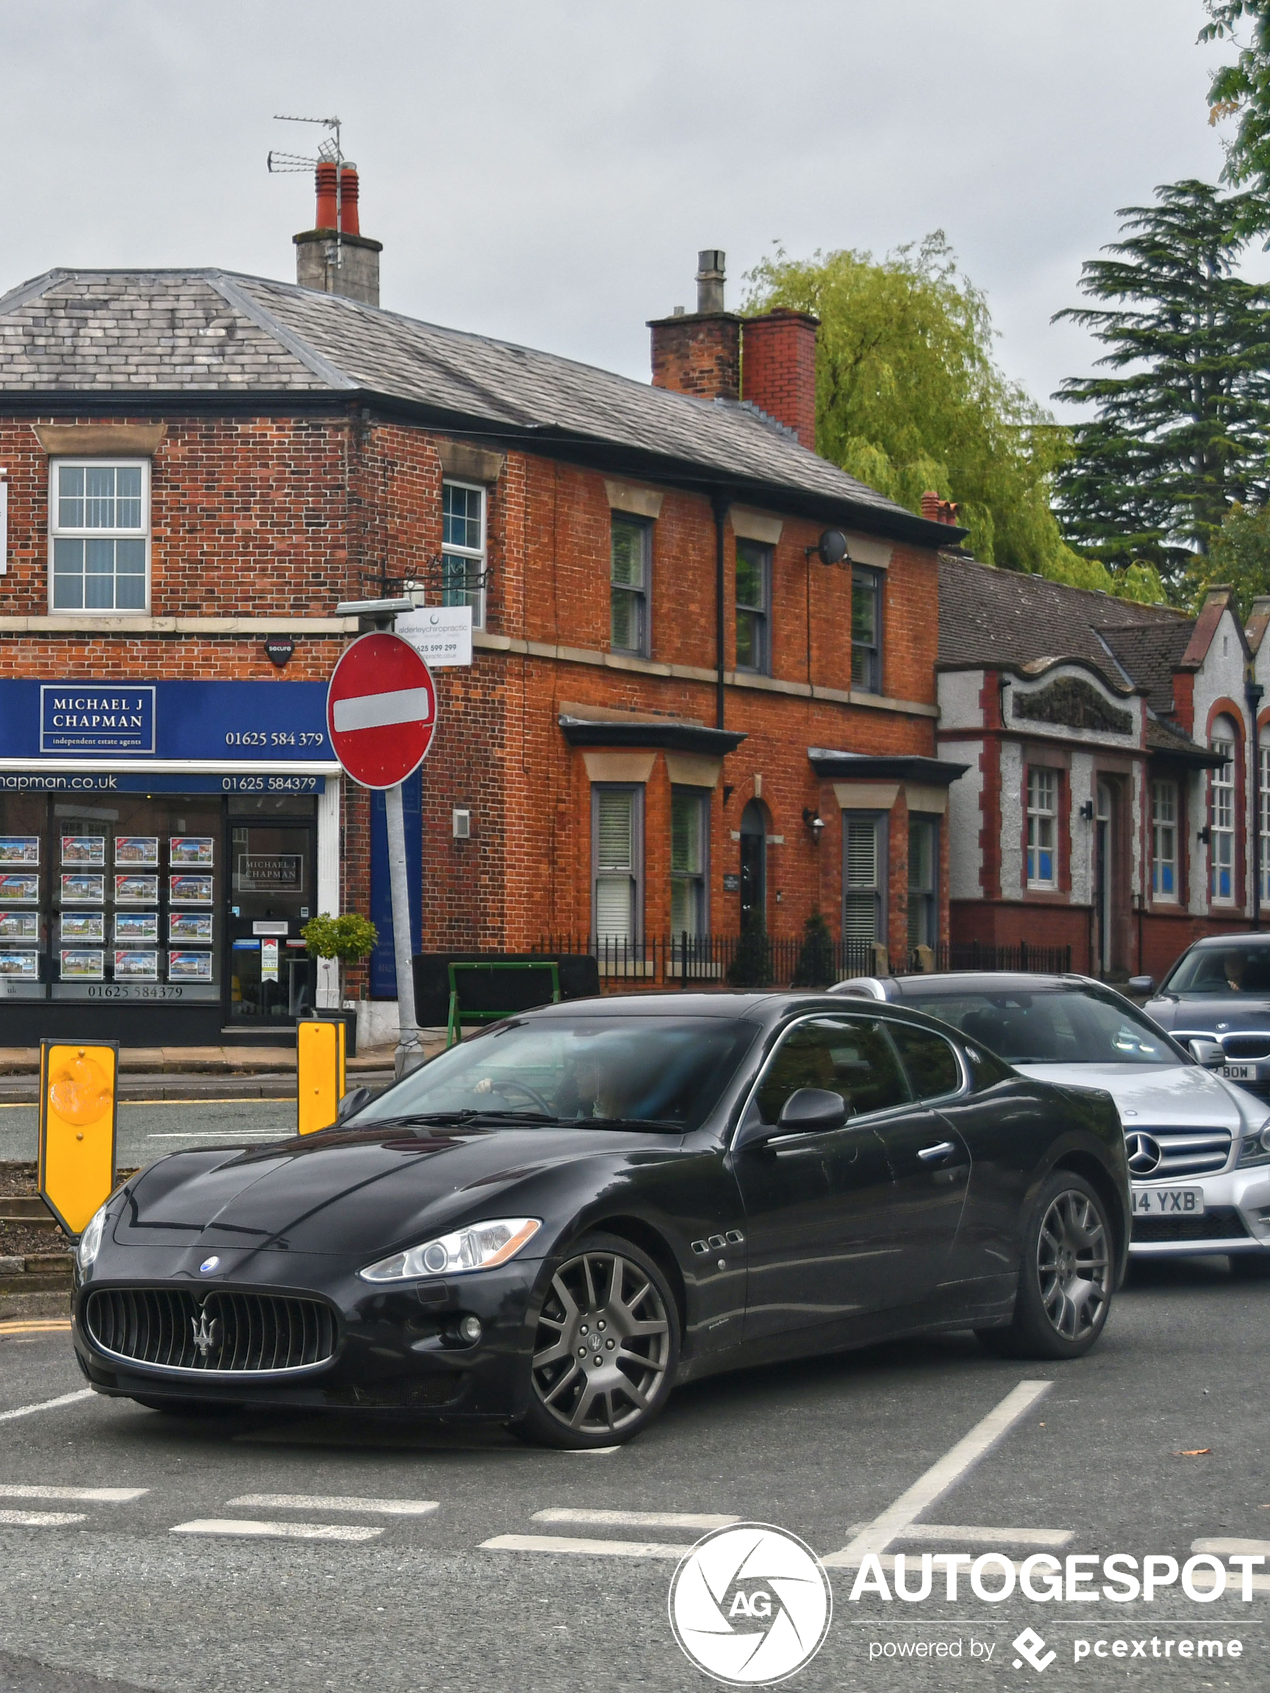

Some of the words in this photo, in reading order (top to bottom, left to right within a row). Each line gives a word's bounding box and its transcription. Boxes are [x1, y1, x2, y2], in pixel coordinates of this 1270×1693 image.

[398, 624, 468, 634] alderleychiropractic
[430, 644, 443, 652] 599
[444, 643, 457, 651] 299
[53, 698, 130, 710] MICHAEL
[136, 699, 143, 710] J
[53, 714, 143, 727] CHAPMAN
[53, 737, 96, 747] independent
[119, 738, 142, 747] agents
[225, 731, 267, 746] 01625
[270, 731, 296, 746] 584
[298, 732, 324, 747] 379
[222, 777, 264, 790] 01625
[267, 777, 317, 790] 584379
[246, 861, 289, 869] MICHAEL
[291, 861, 296, 869] J
[245, 870, 296, 878] CHAPMAN
[88, 985, 129, 998] 01625
[134, 985, 183, 999] 584379
[1223, 1066, 1248, 1078] BOW
[1157, 1191, 1195, 1212] YXB
